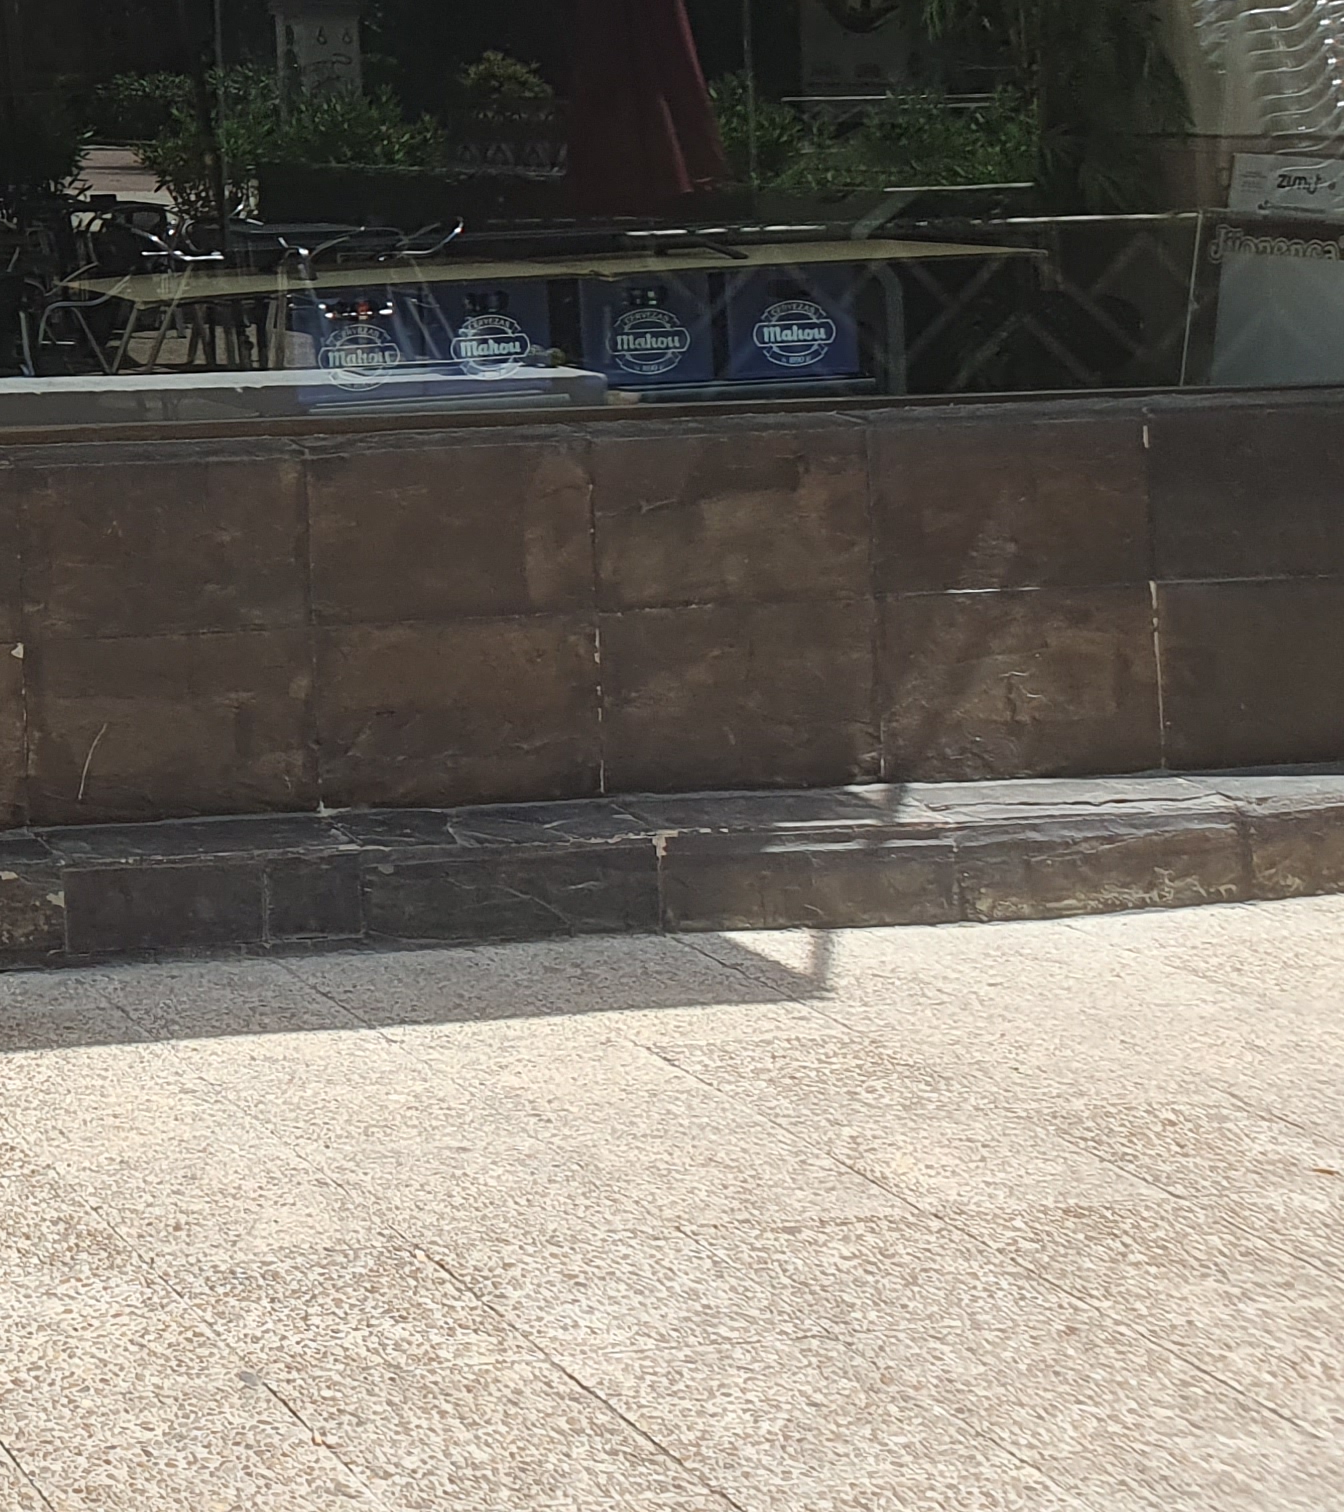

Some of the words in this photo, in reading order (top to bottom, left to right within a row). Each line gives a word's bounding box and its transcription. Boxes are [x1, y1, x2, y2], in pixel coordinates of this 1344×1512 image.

[616, 333, 681, 350] Mahou
[763, 324, 826, 343] Mahou
[460, 338, 521, 357] Mahou
